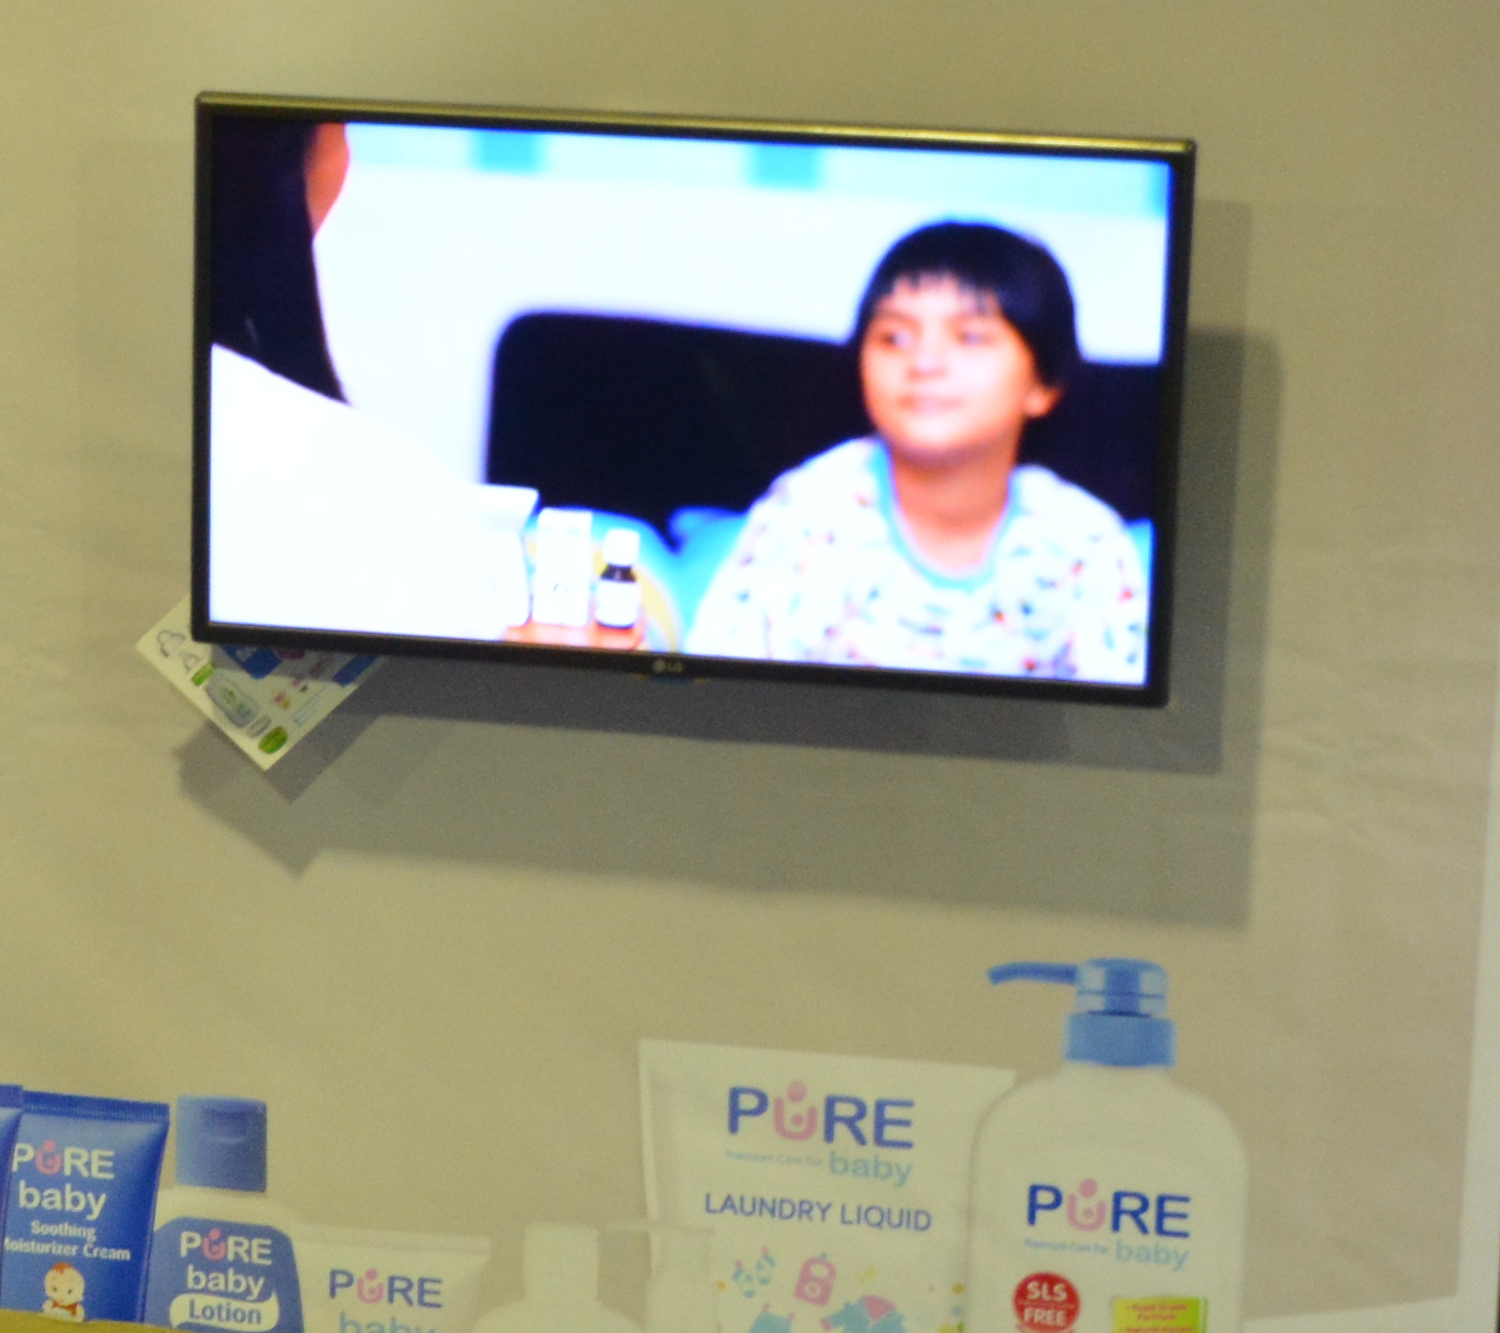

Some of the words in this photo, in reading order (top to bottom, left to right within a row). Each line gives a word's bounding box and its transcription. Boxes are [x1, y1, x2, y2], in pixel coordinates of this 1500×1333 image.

[727, 1080, 915, 1149] PURE
[829, 1150, 913, 1188] baby
[18, 1180, 107, 1222] baby
[705, 1192, 832, 1224] LAUNDRY
[841, 1203, 933, 1232] LIQUID
[1027, 1178, 1191, 1239] PURE
[30, 1220, 97, 1242] Soothing
[179, 1228, 273, 1265] PURE
[82, 1242, 132, 1262] Cream
[1116, 1239, 1190, 1272] baby
[185, 1265, 265, 1300] baby
[329, 1267, 444, 1309] PURE
[1026, 1281, 1067, 1302] SLS
[188, 1300, 262, 1326] Lotion
[1023, 1307, 1067, 1327] FREE
